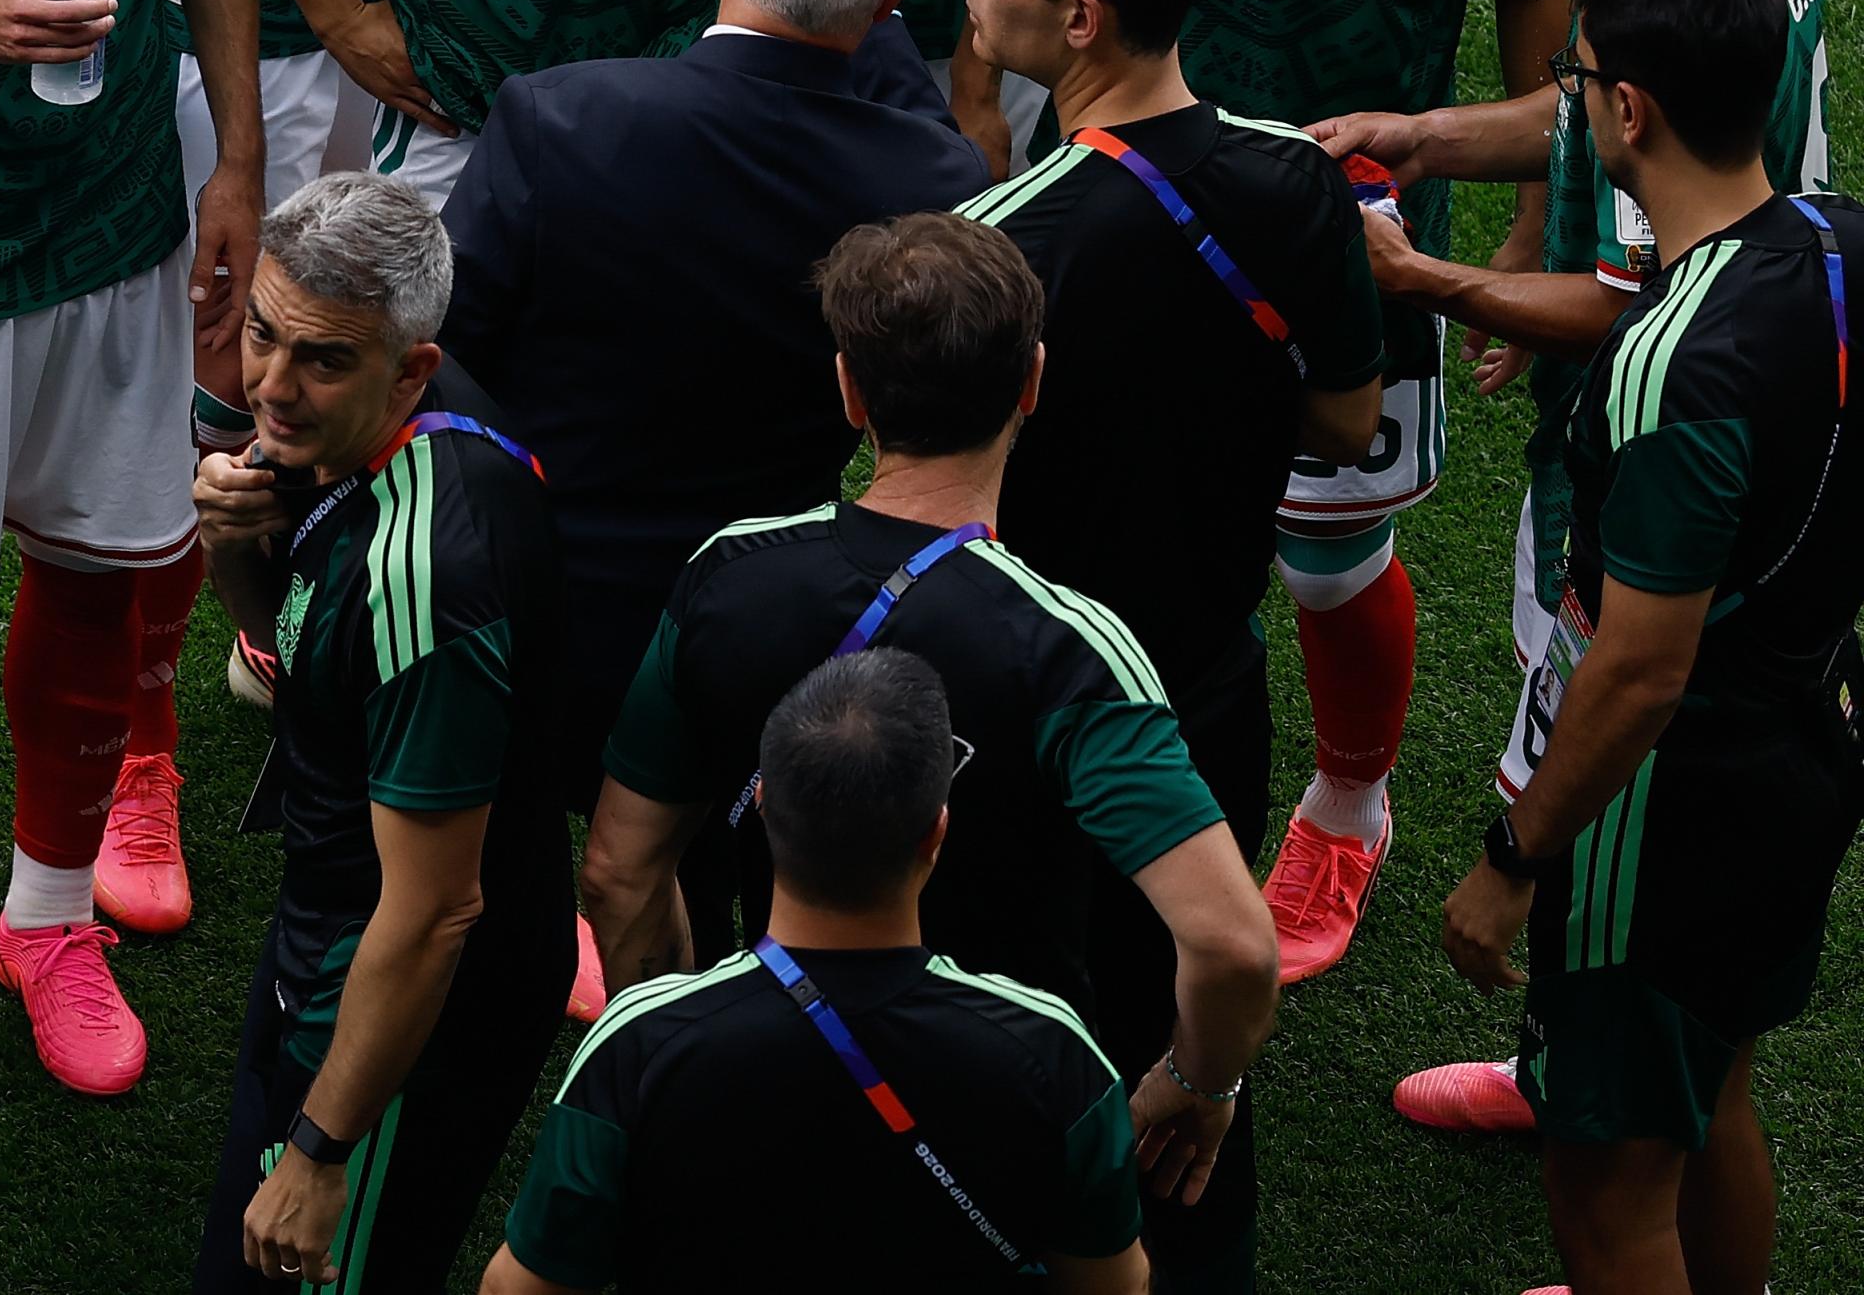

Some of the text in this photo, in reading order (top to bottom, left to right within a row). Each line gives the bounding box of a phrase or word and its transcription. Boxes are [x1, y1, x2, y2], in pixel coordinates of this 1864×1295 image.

[337, 475, 359, 500] FIFA
[306, 495, 337, 532] WORLD
[915, 1141, 955, 1187] 2026
[950, 1187, 973, 1210] CUP
[969, 1209, 1003, 1247] WORLD
